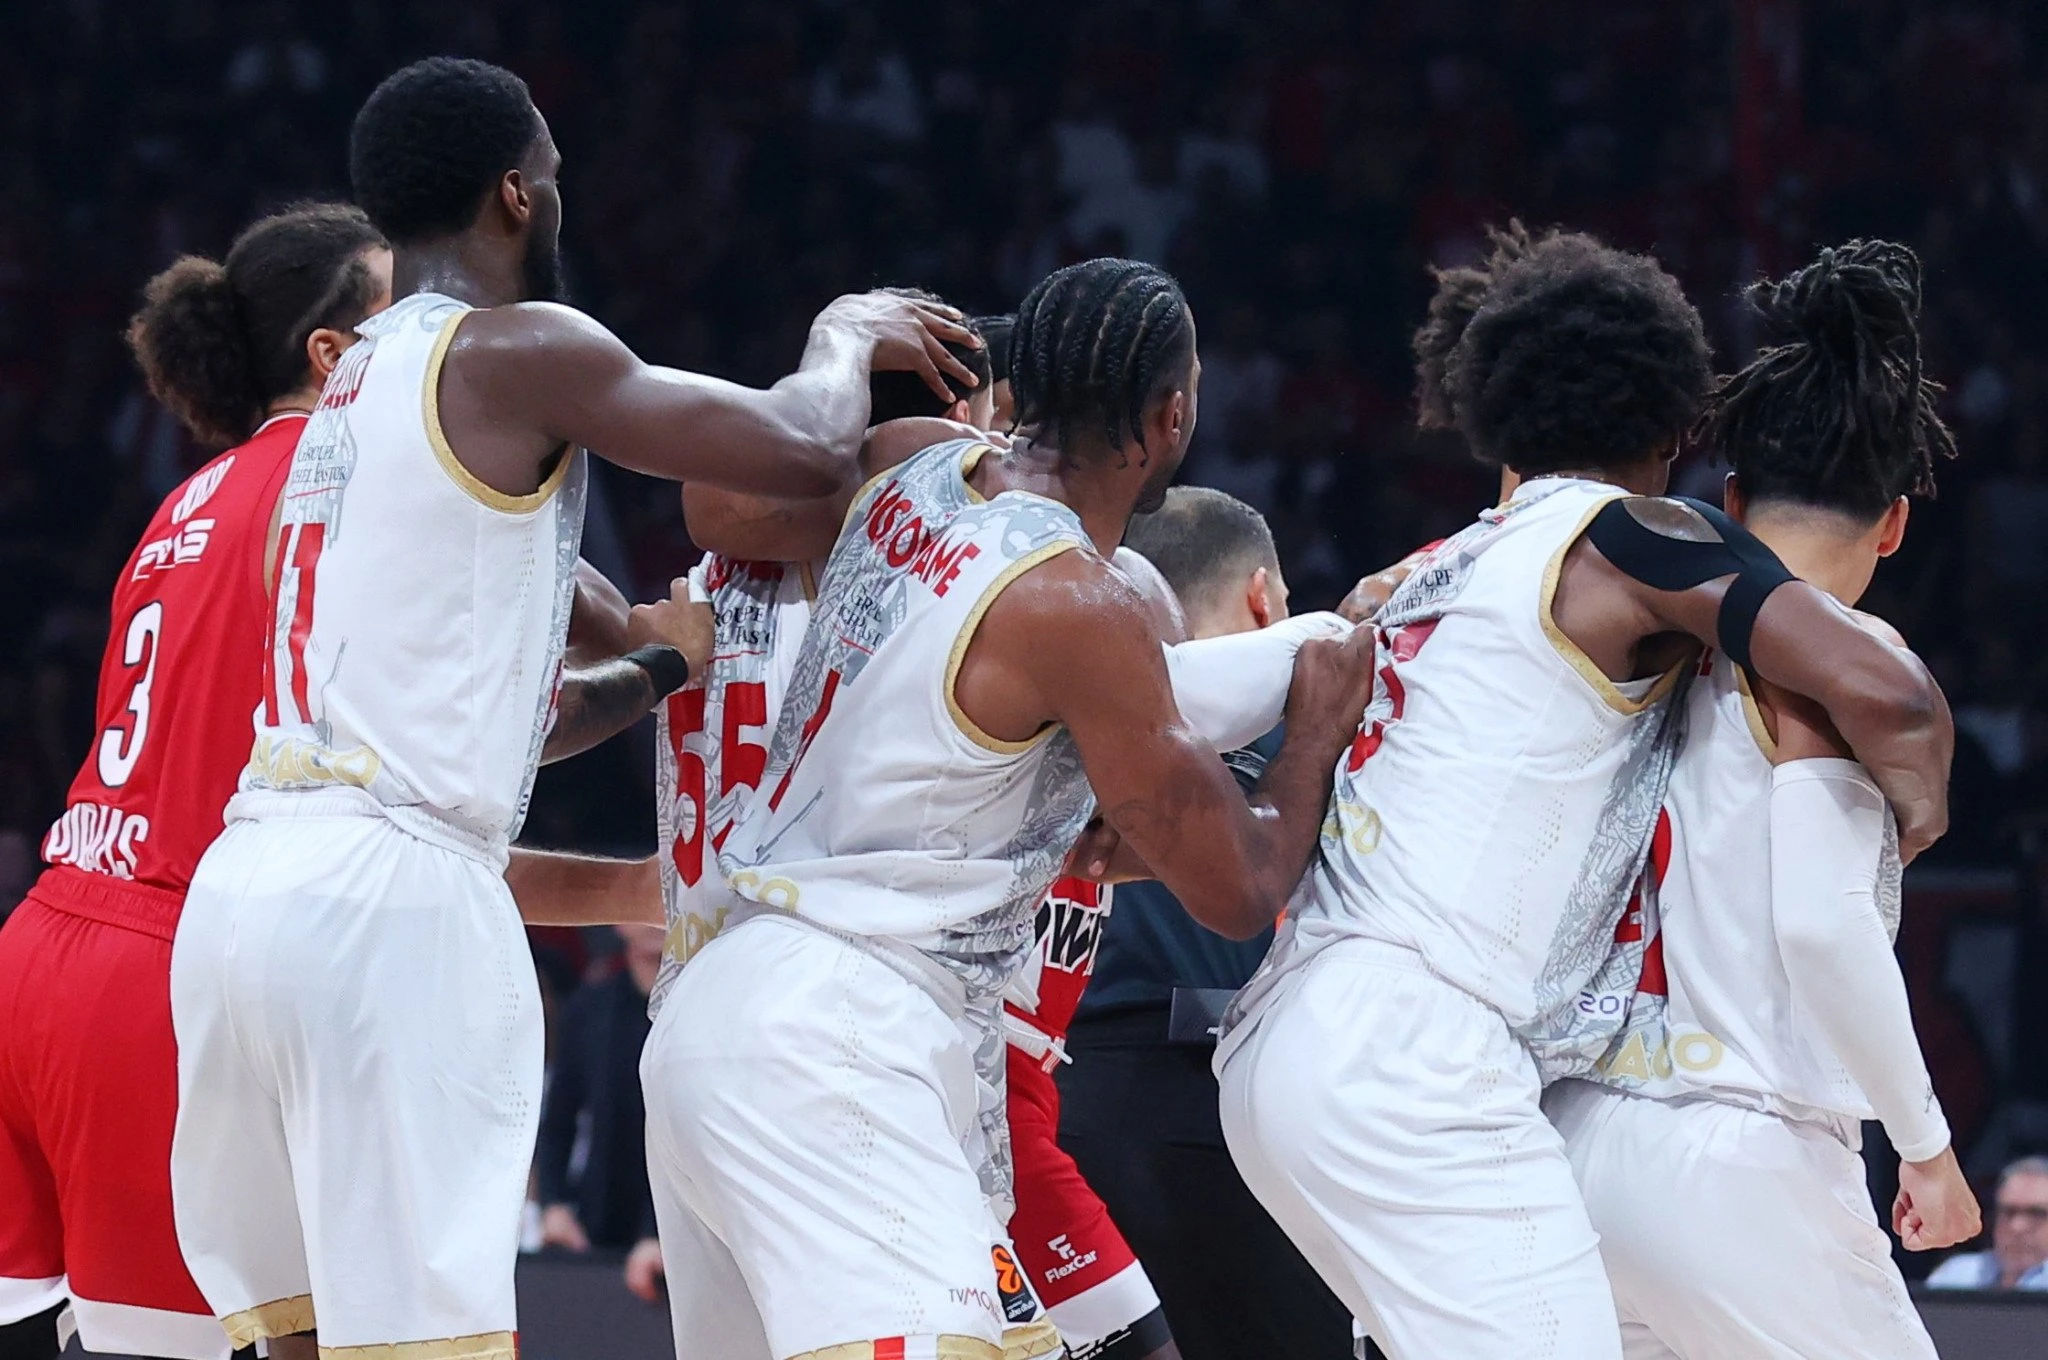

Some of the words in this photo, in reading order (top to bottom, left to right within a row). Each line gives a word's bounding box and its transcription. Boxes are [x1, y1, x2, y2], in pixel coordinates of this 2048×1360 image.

[313, 462, 347, 483] PASTOR
[97, 600, 162, 789] 3
[1044, 1250, 1099, 1284] FlexCar
